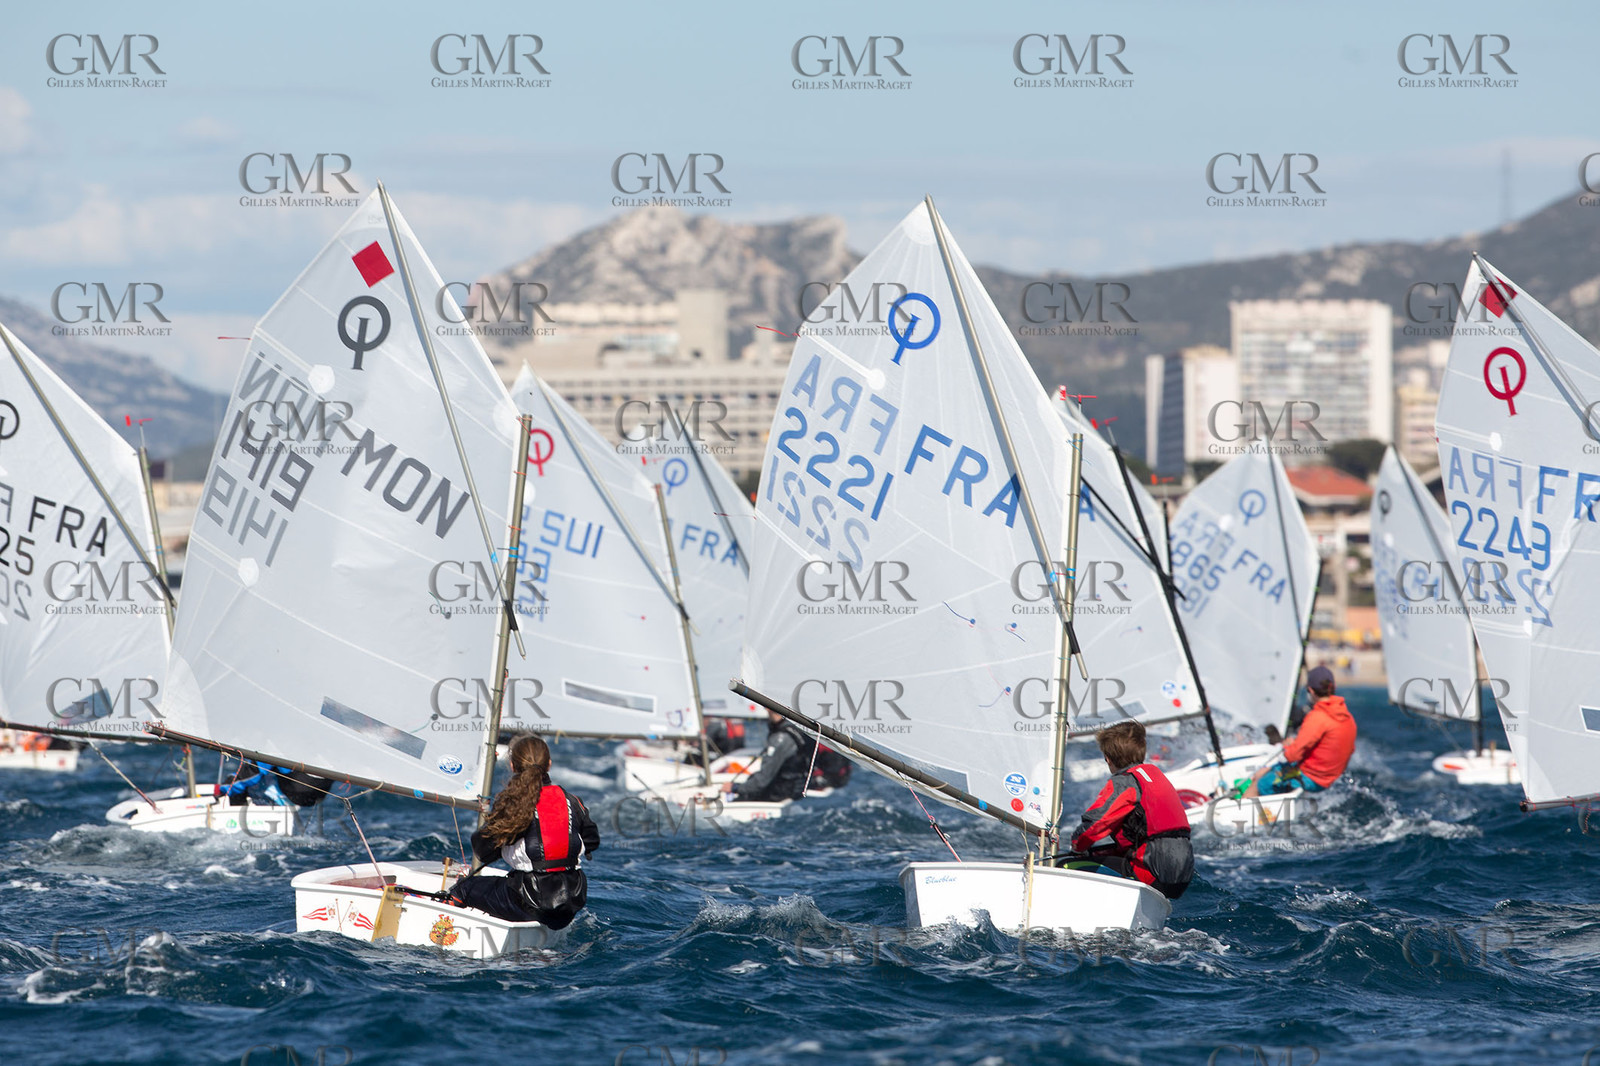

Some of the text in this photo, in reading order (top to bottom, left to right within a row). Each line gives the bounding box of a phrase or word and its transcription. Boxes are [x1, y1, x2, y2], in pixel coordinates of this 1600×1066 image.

[221, 410, 314, 512] 1419
[340, 428, 470, 539] MON
[777, 406, 894, 522] 2221
[904, 424, 1022, 528] FRA
[28, 495, 108, 557] FRA
[540, 509, 603, 558] SUI
[680, 523, 738, 566] FRA
[1231, 549, 1287, 605] FRA
